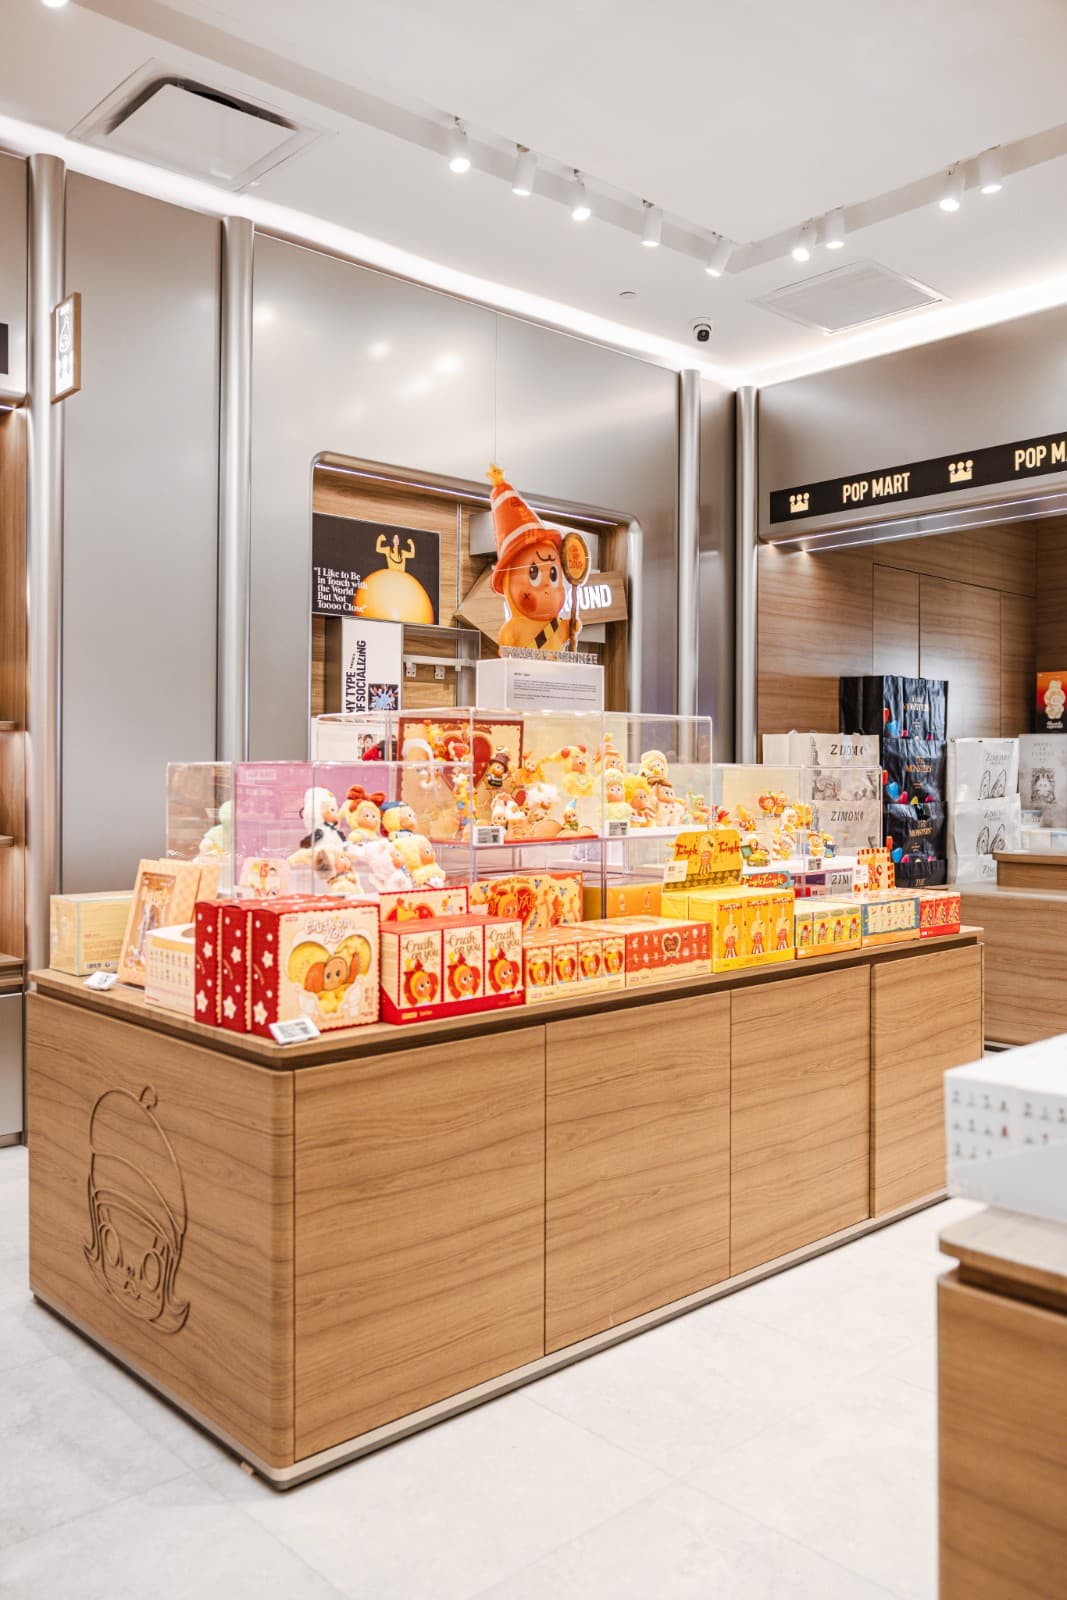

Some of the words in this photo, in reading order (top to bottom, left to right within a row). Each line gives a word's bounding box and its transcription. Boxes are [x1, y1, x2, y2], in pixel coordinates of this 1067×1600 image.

[1015, 445, 1047, 471] POP
[1051, 441, 1067, 464] M
[842, 481, 868, 504] POP
[872, 472, 910, 498] MART
[318, 575, 326, 584] in
[328, 577, 350, 587] Touch
[352, 581, 368, 589] with
[323, 568, 340, 578] Like
[341, 571, 349, 579] to
[351, 572, 360, 580] Be
[318, 584, 330, 592] the
[318, 592, 331, 601] But
[333, 593, 346, 603] Not
[356, 640, 367, 702] SOCIALIZING
[346, 672, 356, 697] TYPE
